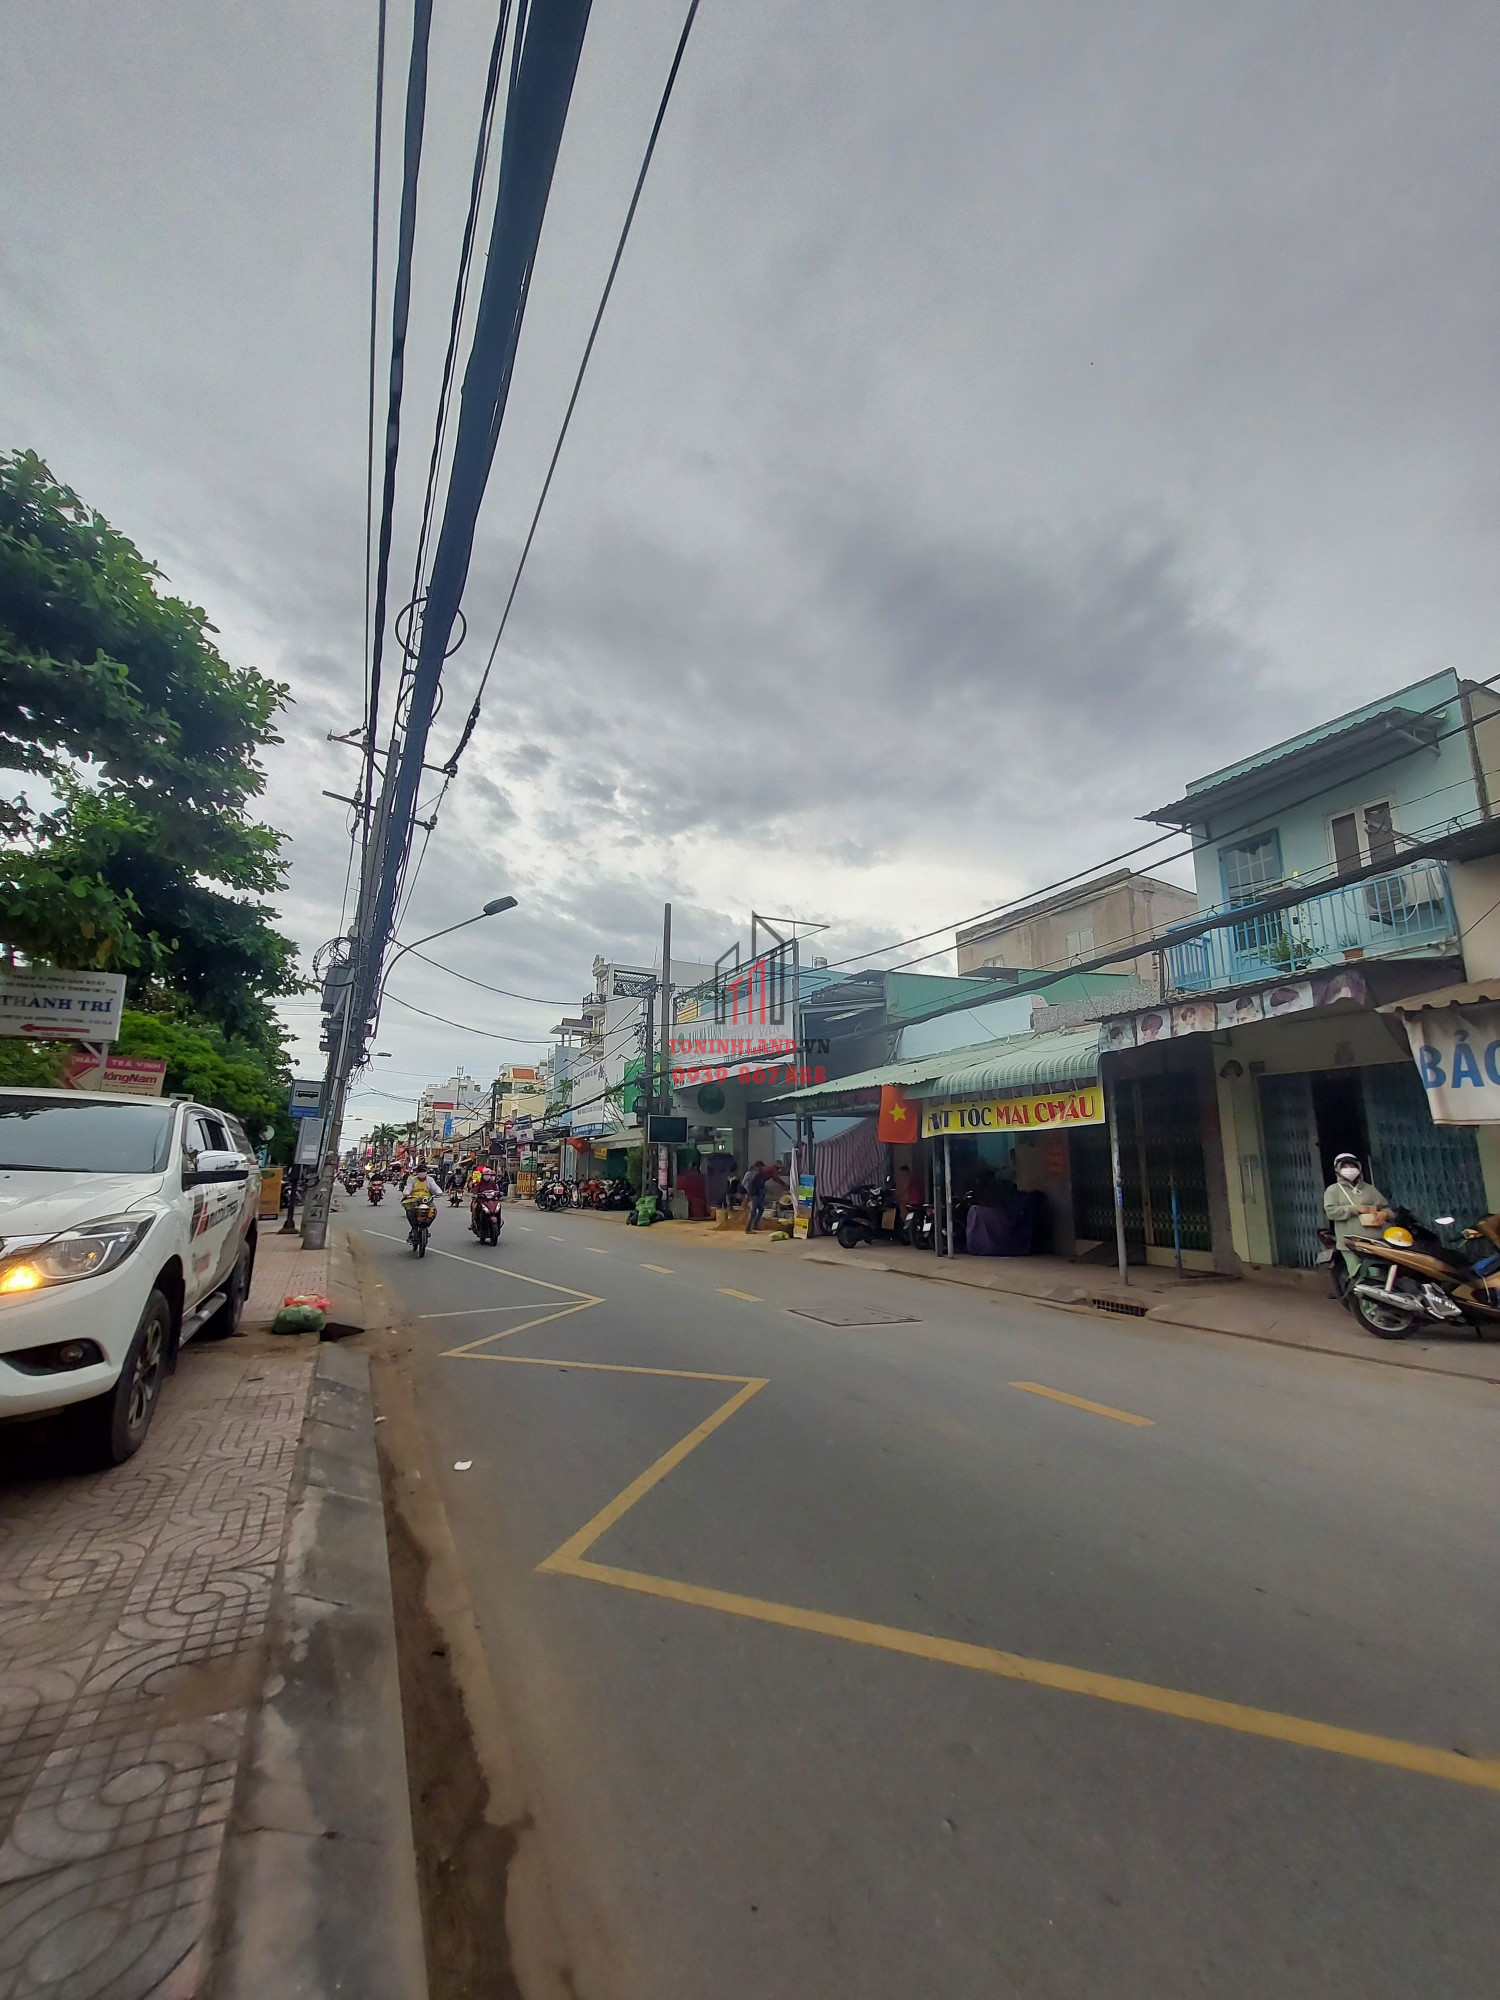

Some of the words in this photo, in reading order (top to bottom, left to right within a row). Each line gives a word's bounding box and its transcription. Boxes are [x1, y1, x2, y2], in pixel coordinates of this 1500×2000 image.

[0, 992, 73, 1010] THÀNH
[77, 997, 114, 1013] TRÍ
[928, 1108, 954, 1132] HT
[957, 1103, 992, 1128] TÓC
[996, 1104, 1031, 1126] MAI
[1034, 1094, 1097, 1123] CHÂU
